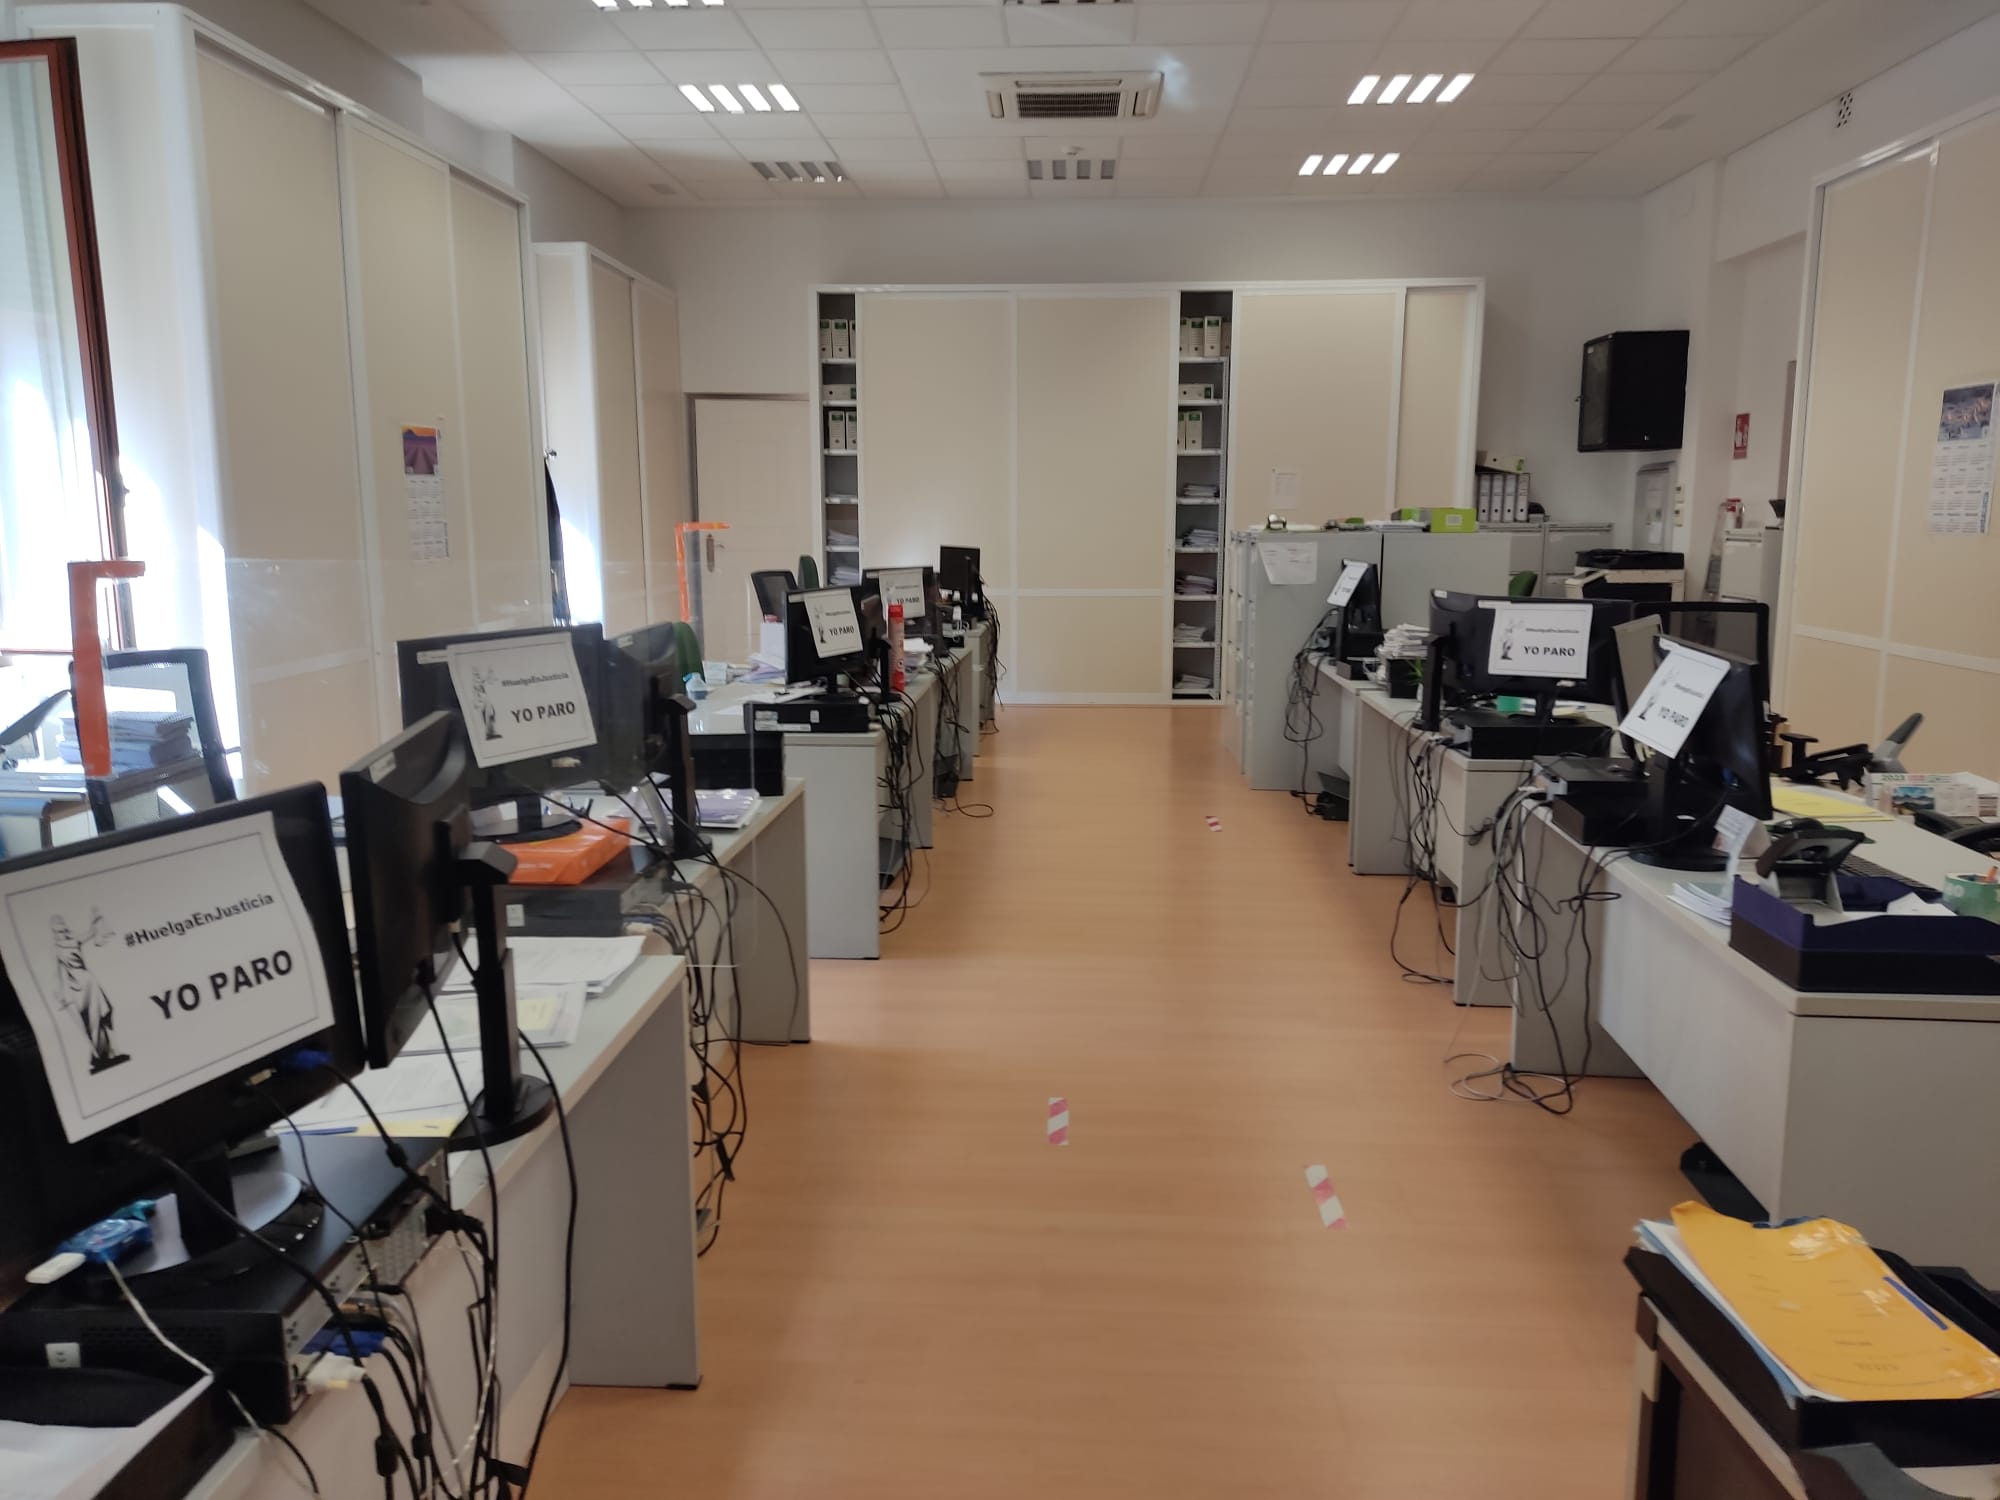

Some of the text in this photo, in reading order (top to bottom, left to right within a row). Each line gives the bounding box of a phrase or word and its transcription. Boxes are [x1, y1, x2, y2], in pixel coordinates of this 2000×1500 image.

[1524, 646, 1576, 657] YO PARO
[512, 701, 576, 723] YO PARO
[124, 892, 275, 948] #HuelgaEnJusticia
[149, 949, 294, 1020] YO PARO
